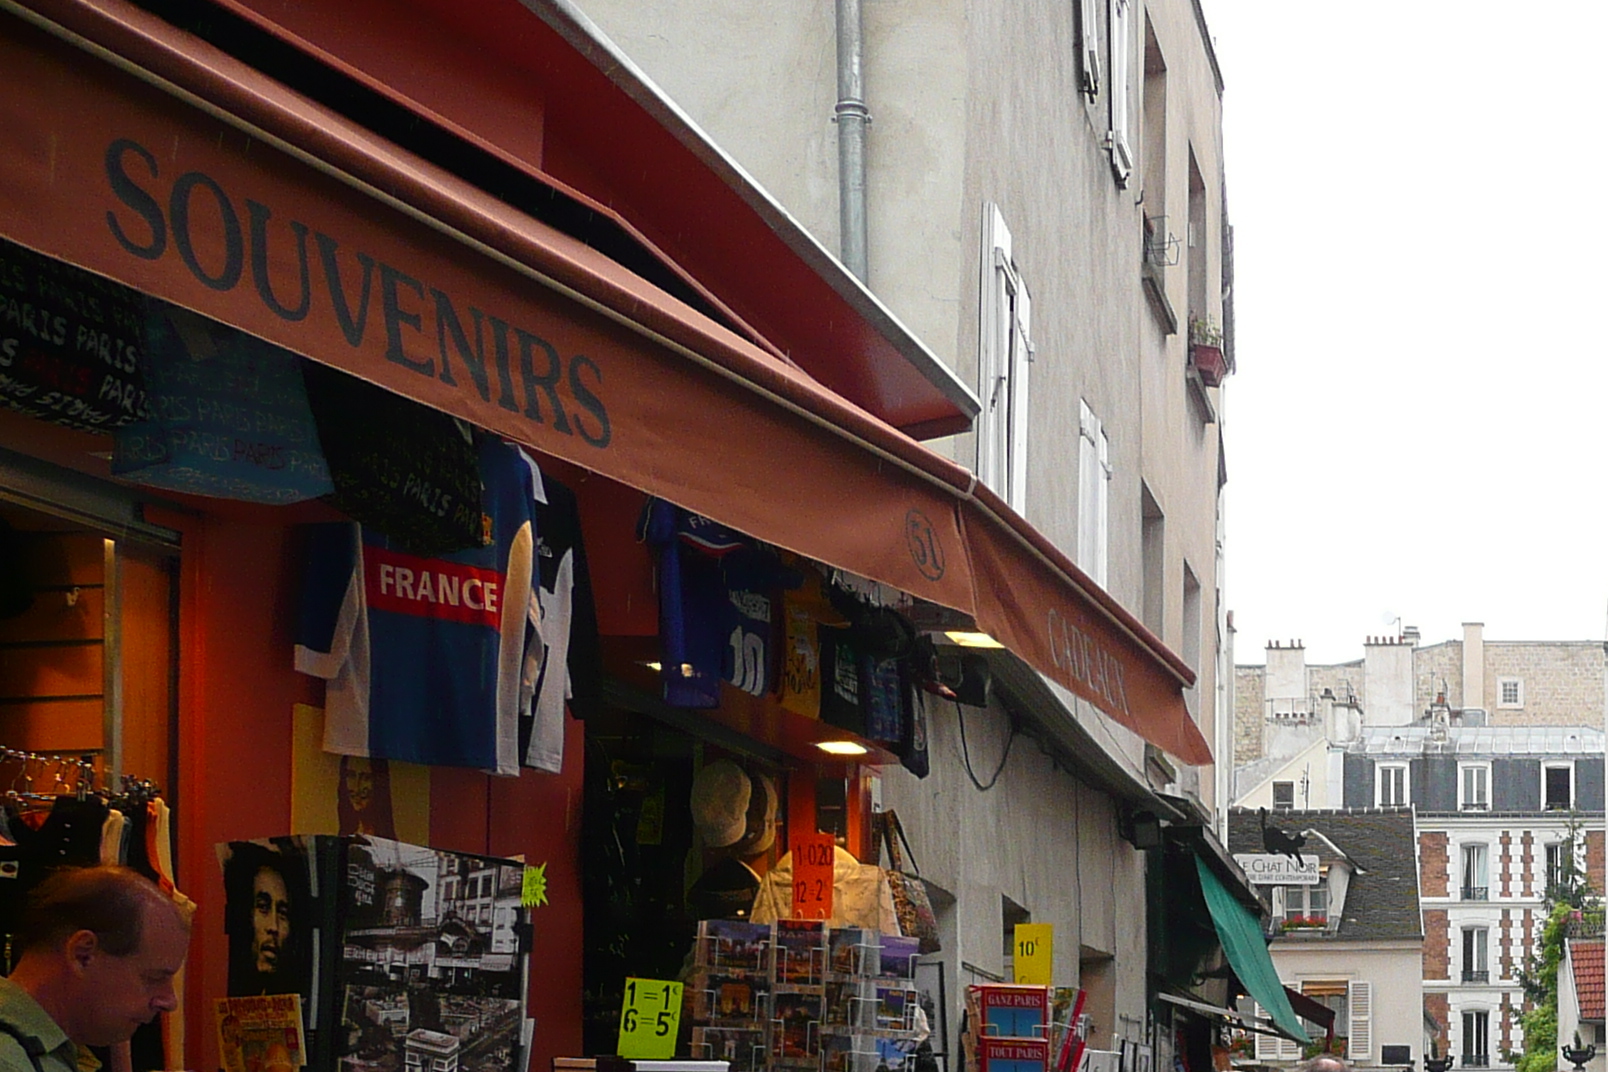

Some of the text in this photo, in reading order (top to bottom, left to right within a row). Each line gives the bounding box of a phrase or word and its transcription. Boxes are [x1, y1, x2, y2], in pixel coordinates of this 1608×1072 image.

[104, 137, 612, 449] SOUVENIRS
[76, 324, 137, 375] PARIS
[403, 472, 452, 518] PARIS
[910, 519, 941, 570] 51
[379, 562, 498, 613] FRANCE
[728, 624, 765, 697] 10
[1048, 607, 1130, 716] CADEAUX
[987, 995, 1041, 1006] GANZ PARIS
[990, 1047, 1042, 1059] TOUT PARIS
